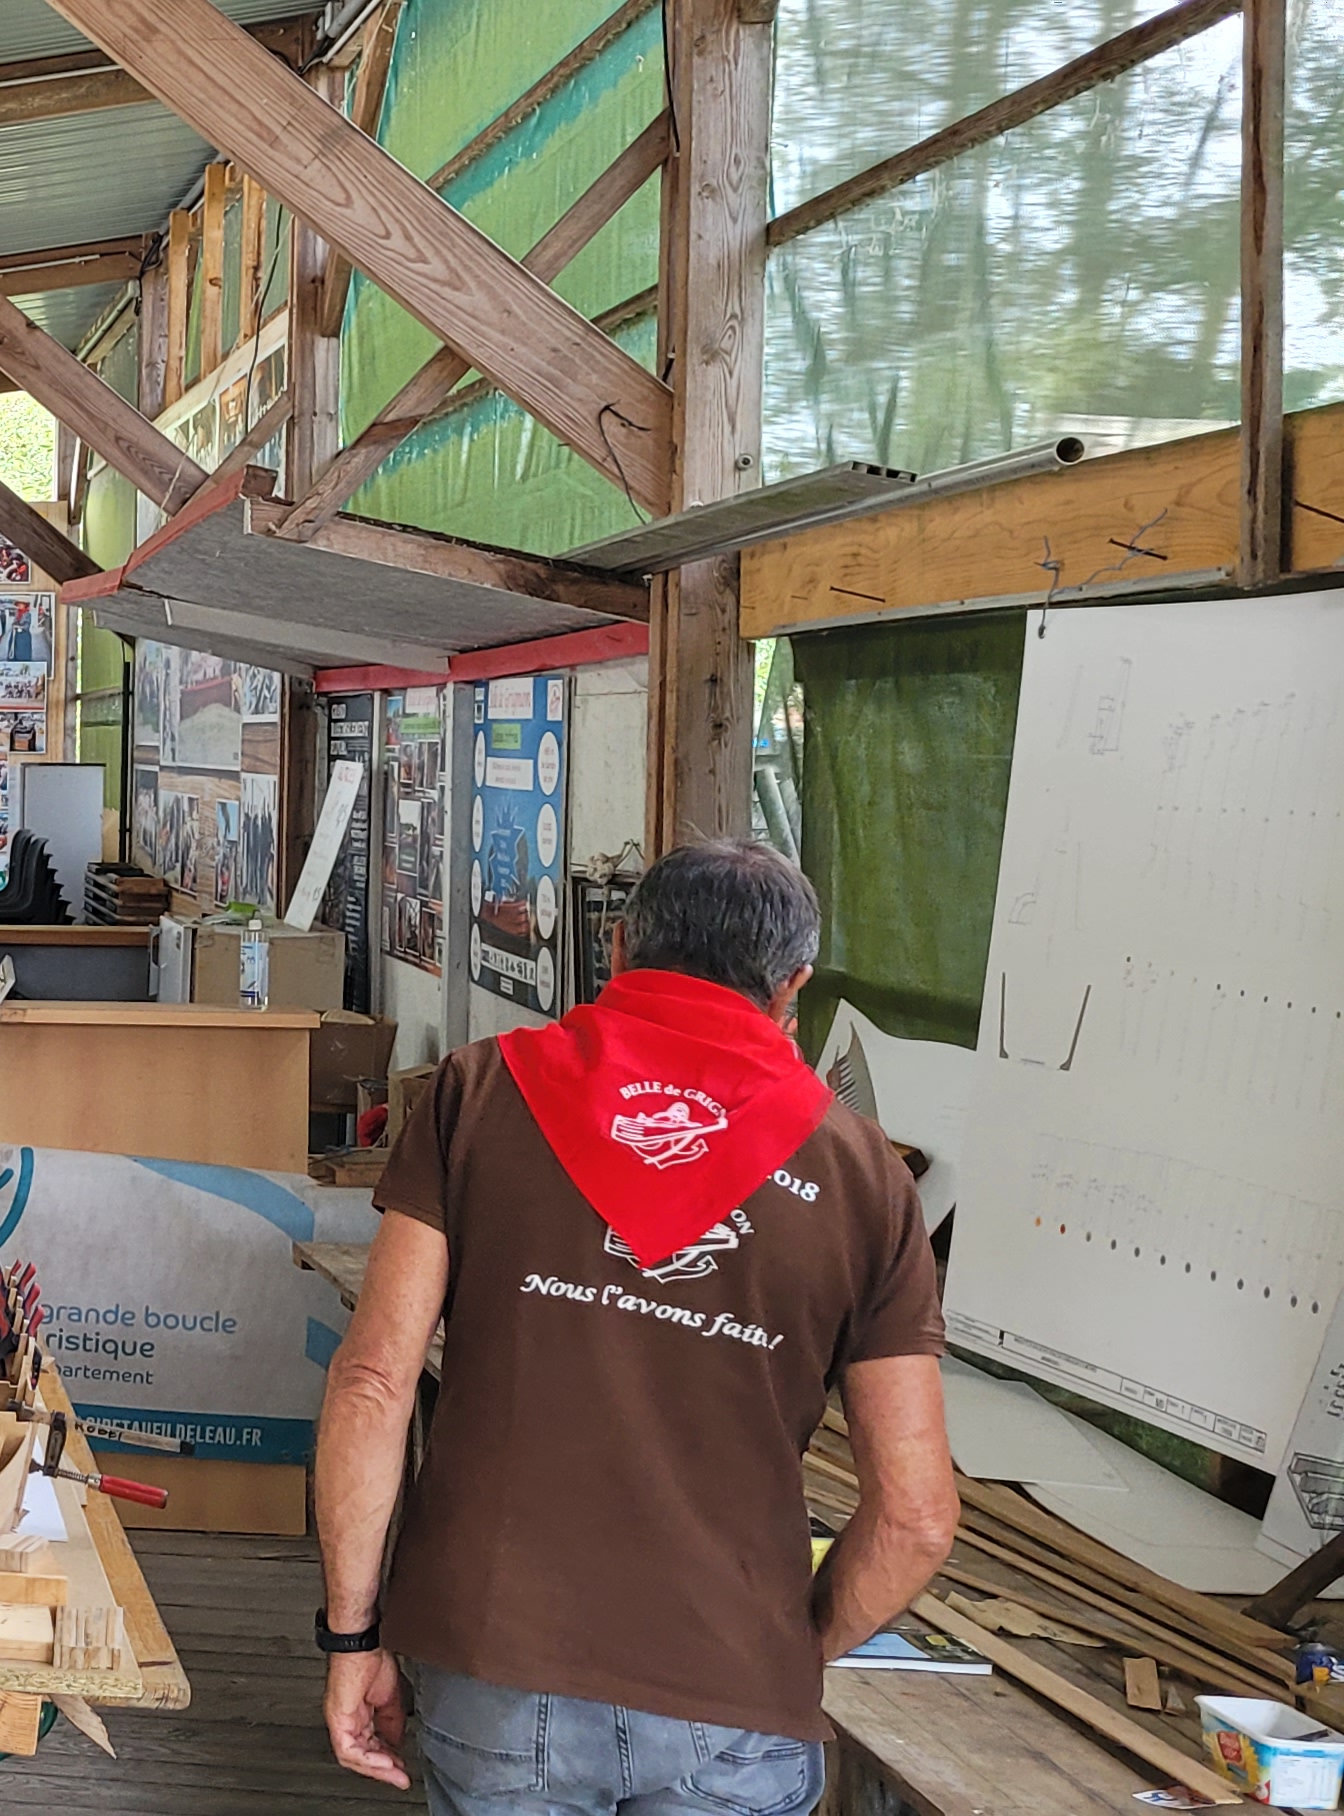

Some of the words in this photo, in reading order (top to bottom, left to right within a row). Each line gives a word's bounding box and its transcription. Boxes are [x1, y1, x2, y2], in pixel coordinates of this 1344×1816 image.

[619, 1081, 663, 1100] BELLE
[664, 1084, 682, 1097] de
[683, 1087, 726, 1117] GRIG
[766, 1169, 821, 1202] 018
[520, 1273, 598, 1304] Nous
[601, 1284, 708, 1328] l'avons
[41, 1304, 137, 1327] grande
[144, 1305, 238, 1335] boucle
[45, 1328, 156, 1361] ristique
